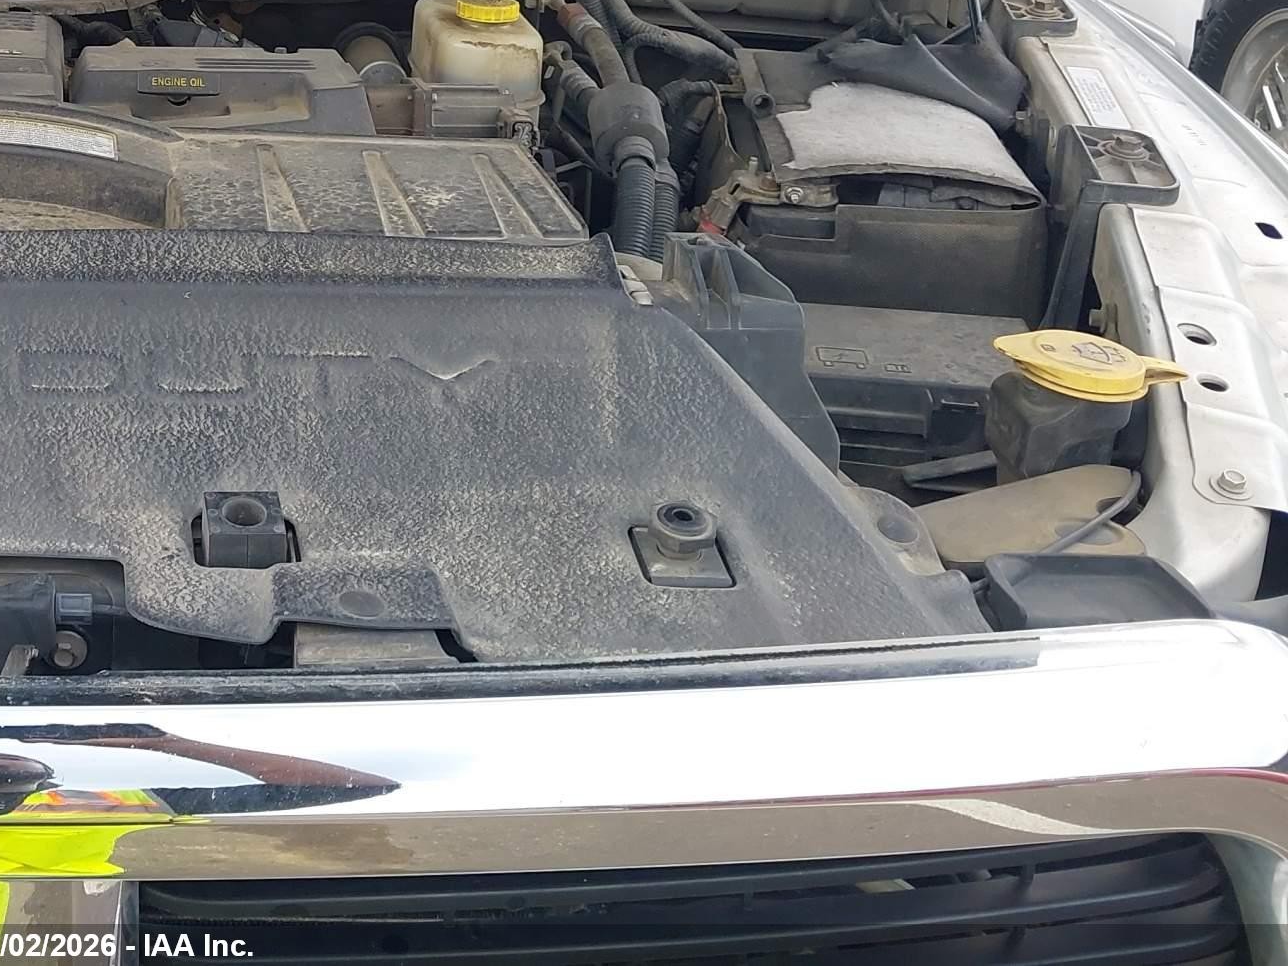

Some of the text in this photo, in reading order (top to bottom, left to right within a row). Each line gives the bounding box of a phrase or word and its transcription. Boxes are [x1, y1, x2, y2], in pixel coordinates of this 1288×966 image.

[151, 77, 206, 87] ENGINE OIL
[14, 348, 500, 408] DUTY
